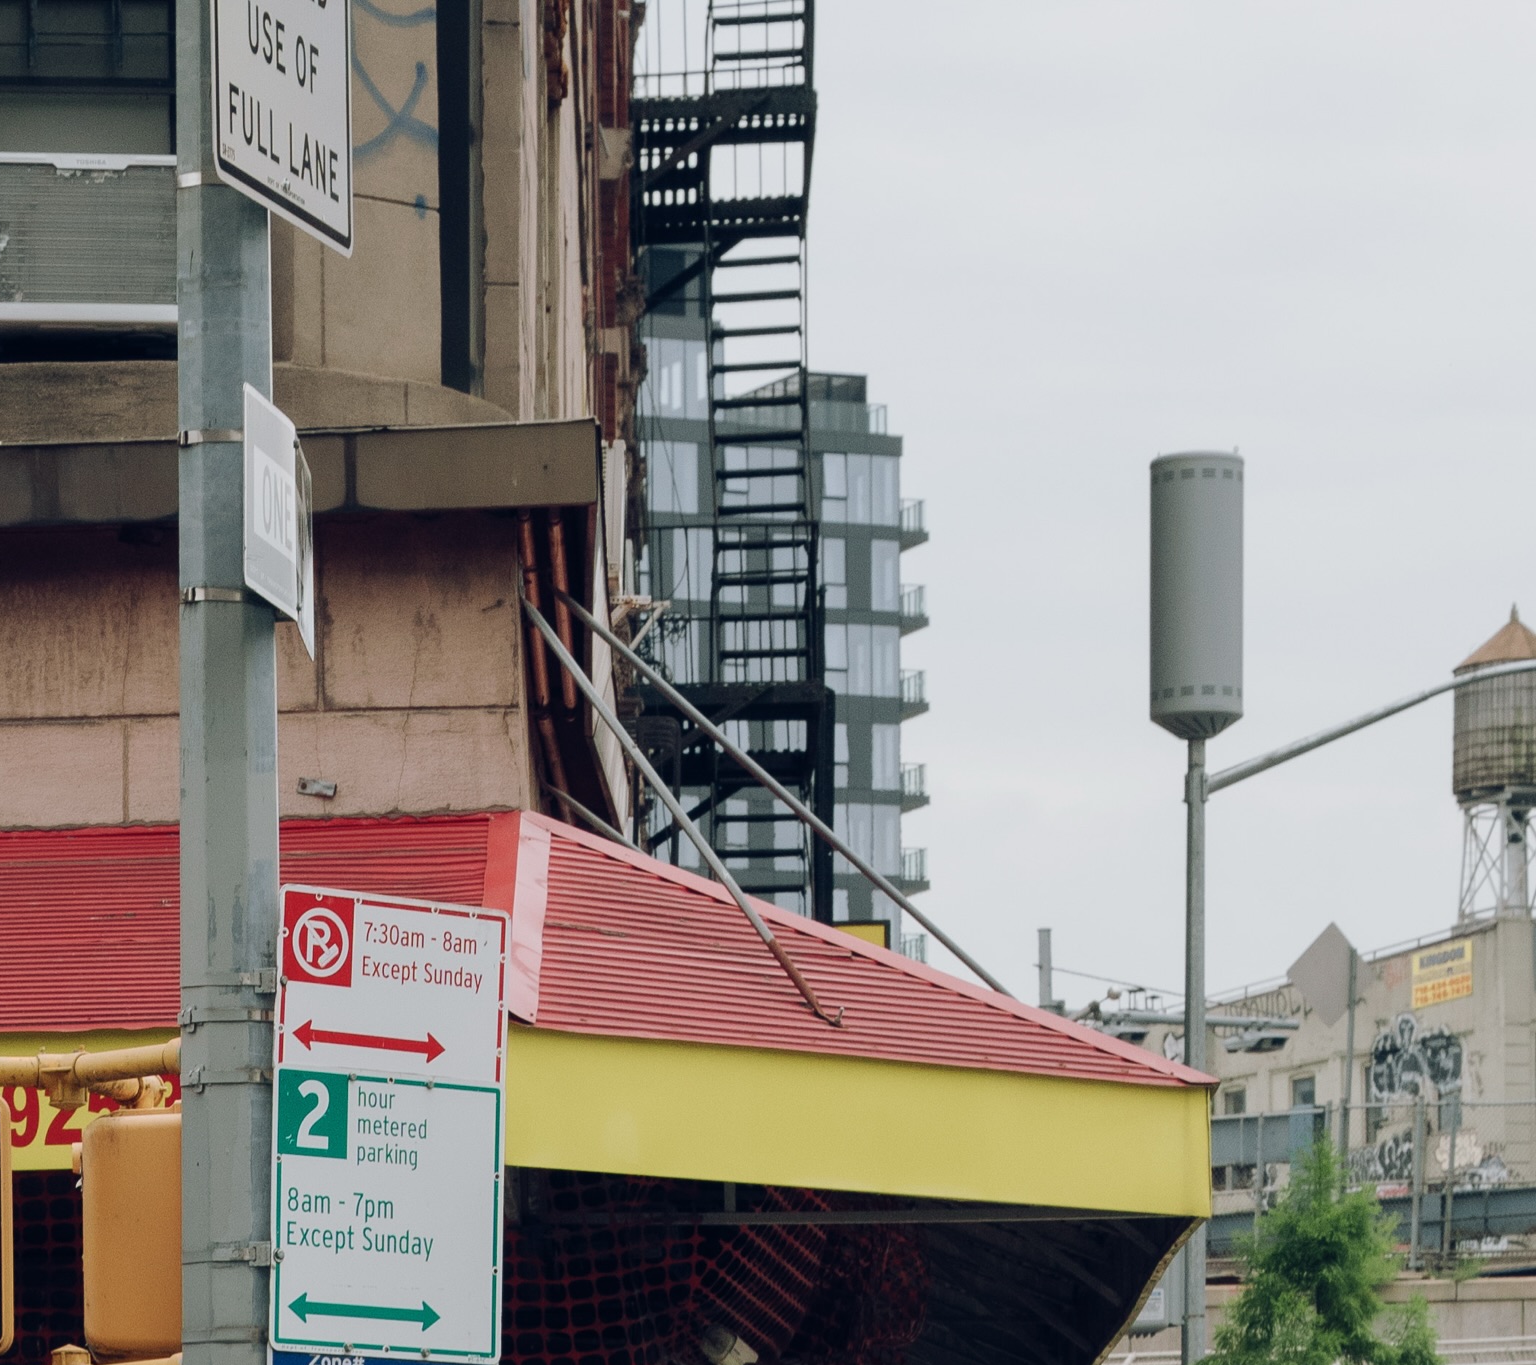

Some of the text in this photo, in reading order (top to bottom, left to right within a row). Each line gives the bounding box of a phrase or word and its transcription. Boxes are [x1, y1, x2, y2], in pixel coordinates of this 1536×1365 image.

[248, 0, 319, 94] USE OF
[229, 82, 339, 203] FULL LANE
[263, 464, 293, 553] ONE
[364, 921, 425, 949] 7:30am
[443, 931, 478, 955] 8am
[362, 956, 483, 994] Except Sunday
[296, 1079, 396, 1150] 2 hour
[357, 1115, 427, 1140] metered
[357, 1143, 419, 1171] parking
[287, 1187, 331, 1214] 8am
[353, 1193, 394, 1223] 7pm
[287, 1221, 434, 1262] Except Sunday
